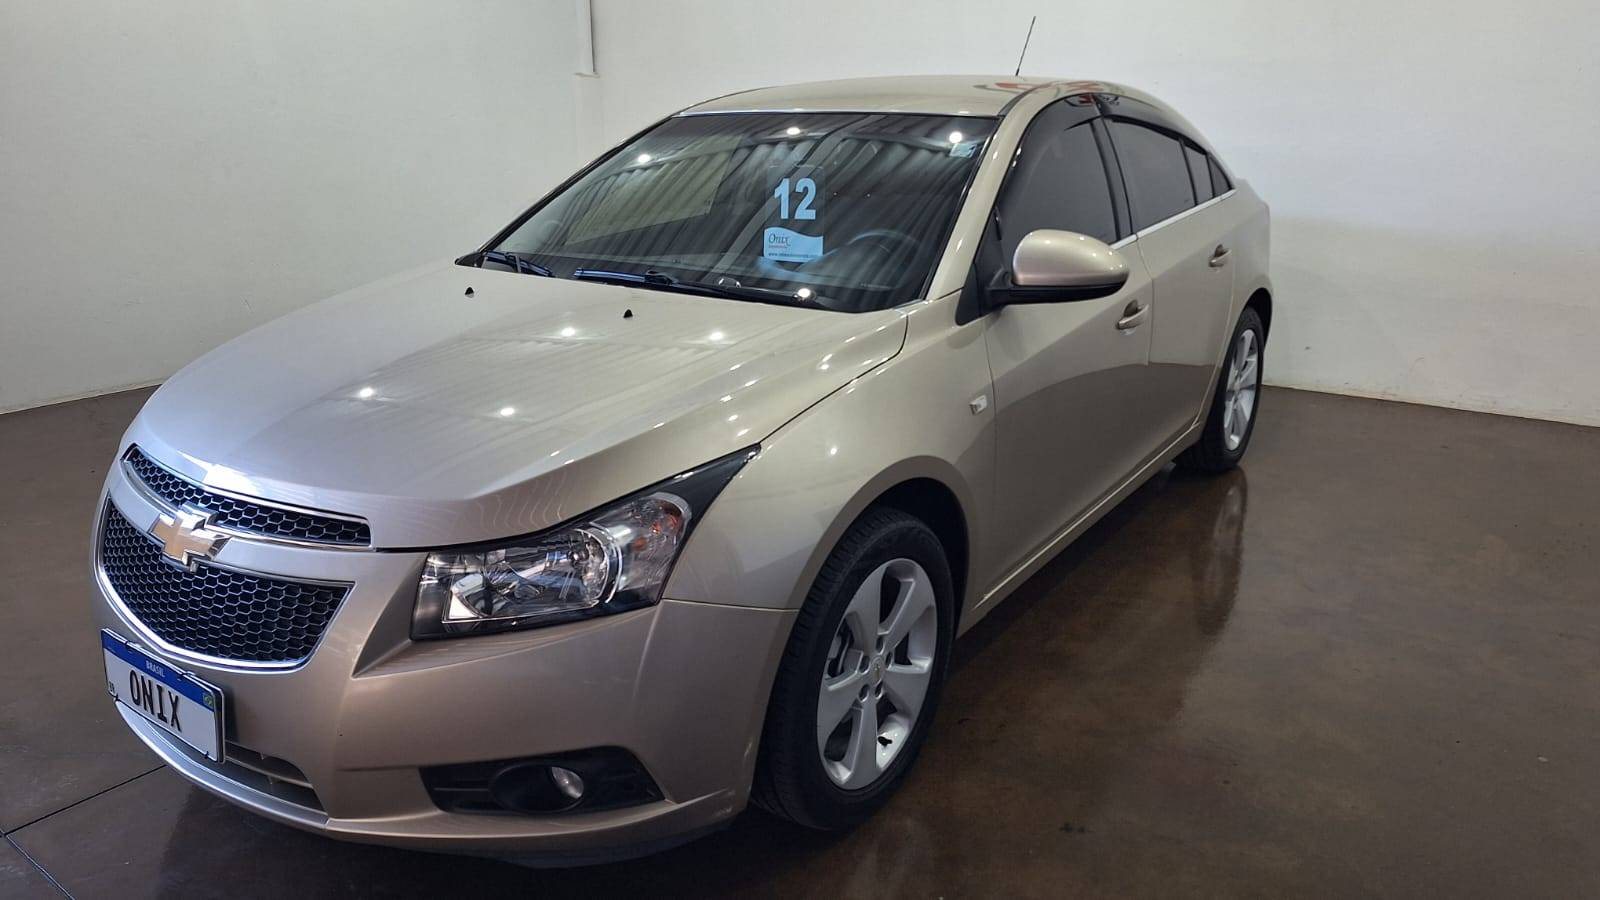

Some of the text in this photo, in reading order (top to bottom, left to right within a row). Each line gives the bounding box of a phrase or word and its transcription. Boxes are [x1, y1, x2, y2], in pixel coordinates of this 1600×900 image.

[774, 177, 816, 220] 12
[768, 233, 791, 247] Onix
[145, 660, 166, 678] BRASIL
[129, 669, 182, 733] ONIX
